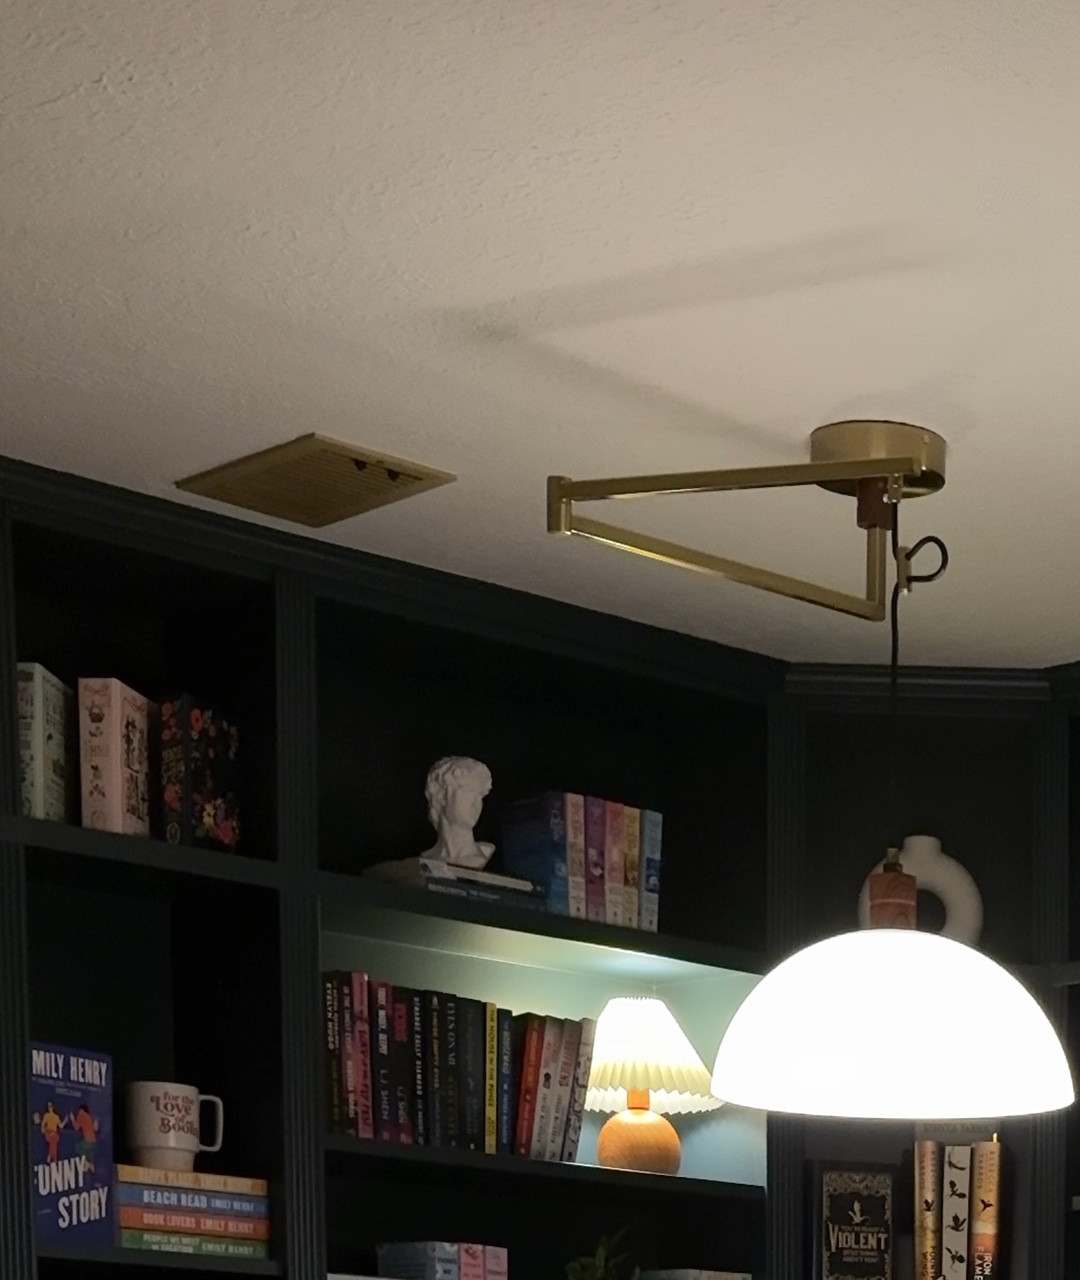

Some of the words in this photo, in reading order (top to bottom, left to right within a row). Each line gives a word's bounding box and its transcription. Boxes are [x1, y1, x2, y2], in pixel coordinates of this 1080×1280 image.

[32, 1049, 64, 1080] MILY
[70, 1056, 108, 1087] HENRY
[150, 1096, 193, 1118] Love
[57, 1186, 109, 1230] STORY
[143, 1190, 178, 1206] BEACH
[181, 1192, 208, 1208] READ
[142, 1211, 165, 1226] BOOK
[167, 1214, 197, 1230] LOVERS
[200, 1216, 226, 1232] EMILY
[201, 1241, 226, 1255] EMILY
[827, 1221, 889, 1253] VIOLENT
[920, 1252, 929, 1277] WING
[982, 1253, 993, 1276] IRON
